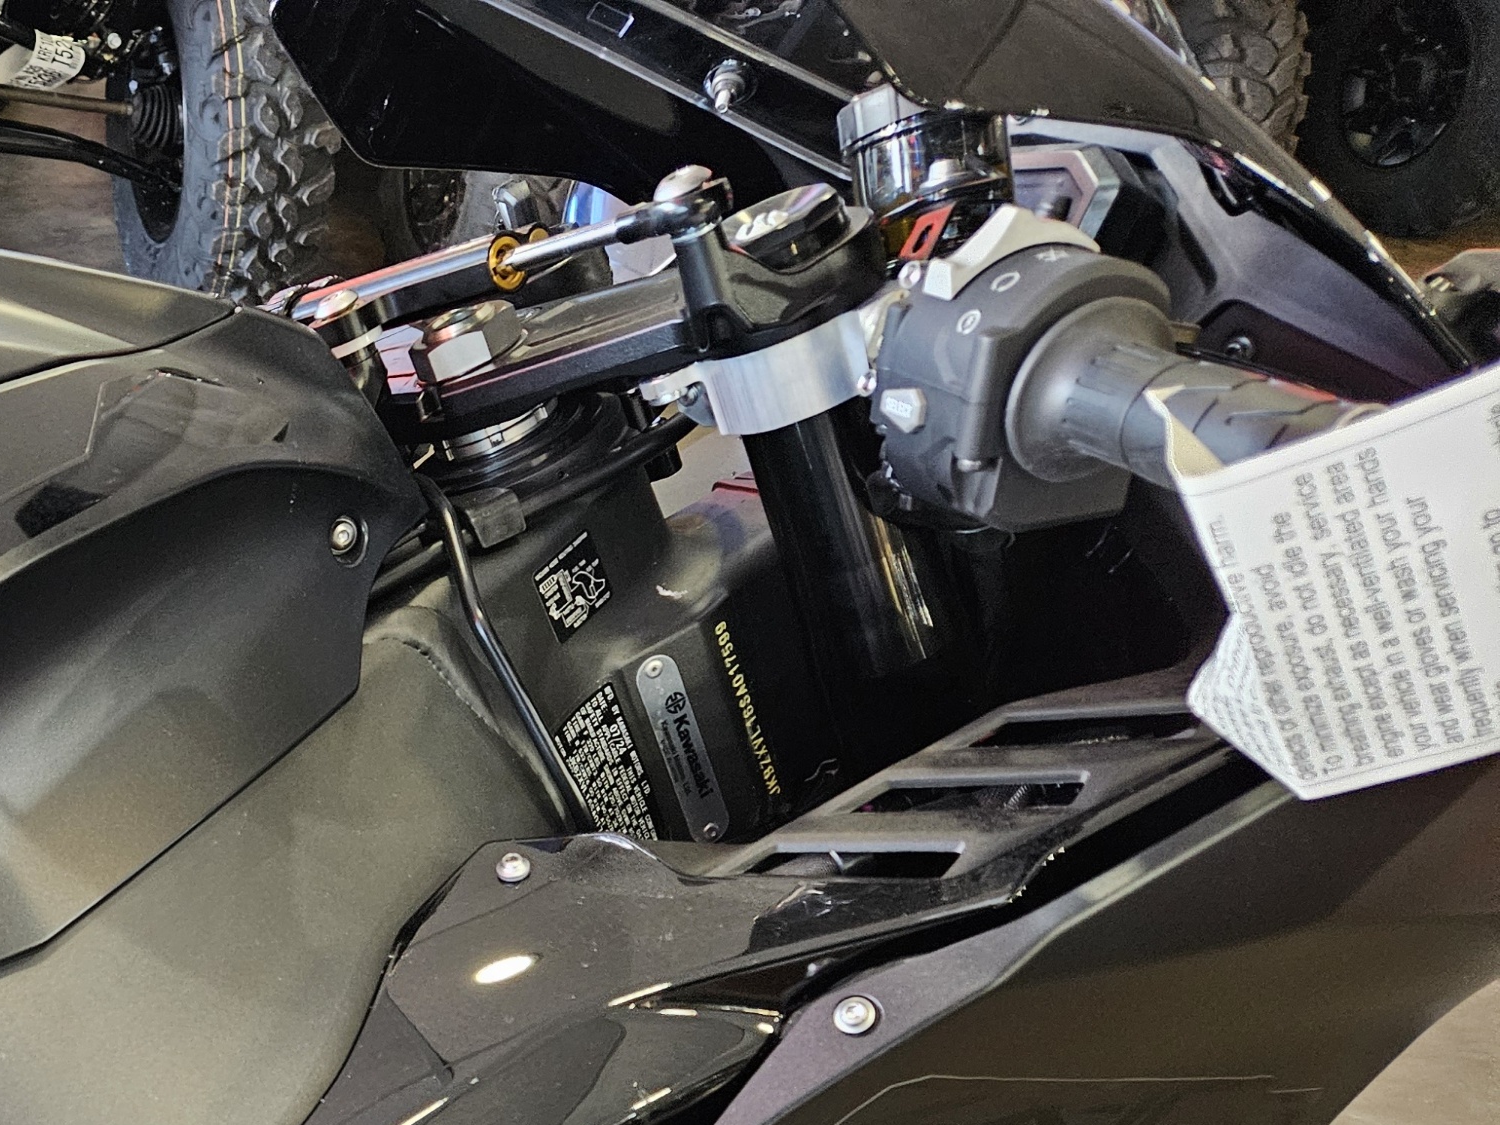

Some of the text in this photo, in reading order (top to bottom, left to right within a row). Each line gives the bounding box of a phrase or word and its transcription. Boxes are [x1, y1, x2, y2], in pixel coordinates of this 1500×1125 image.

[1330, 461, 1352, 507] area
[1354, 445, 1389, 509] hands
[1272, 510, 1295, 545] the
[1293, 471, 1330, 543] service
[1379, 506, 1408, 554] your
[1409, 489, 1440, 538] your
[1254, 562, 1284, 614] avoid
[1297, 581, 1317, 612] not
[1338, 508, 1394, 637] well-ventilated
[1388, 555, 1418, 604] wash
[1421, 537, 1466, 620] servicing
[1306, 612, 1325, 639] do
[1405, 603, 1425, 624] or
[1350, 639, 1369, 661] as
[1382, 635, 1400, 649] a
[1410, 622, 1447, 681] gloves
[1443, 619, 1471, 668] when
[583, 701, 599, 727] SAFETY
[614, 776, 629, 802] EFFECT
[589, 696, 599, 708] TO
[594, 707, 605, 724] ALL
[600, 723, 622, 765] APPLICABLE
[616, 764, 633, 794] FEDERAL
[594, 690, 609, 713] DATE:
[606, 722, 628, 756] 07/24
[625, 765, 637, 784] THIS
[632, 783, 648, 813] VEHICLE
[615, 715, 634, 749] KAWASAKI
[640, 779, 652, 796] LTD.
[672, 712, 714, 799] Kawasaki
[1439, 716, 1462, 748] and
